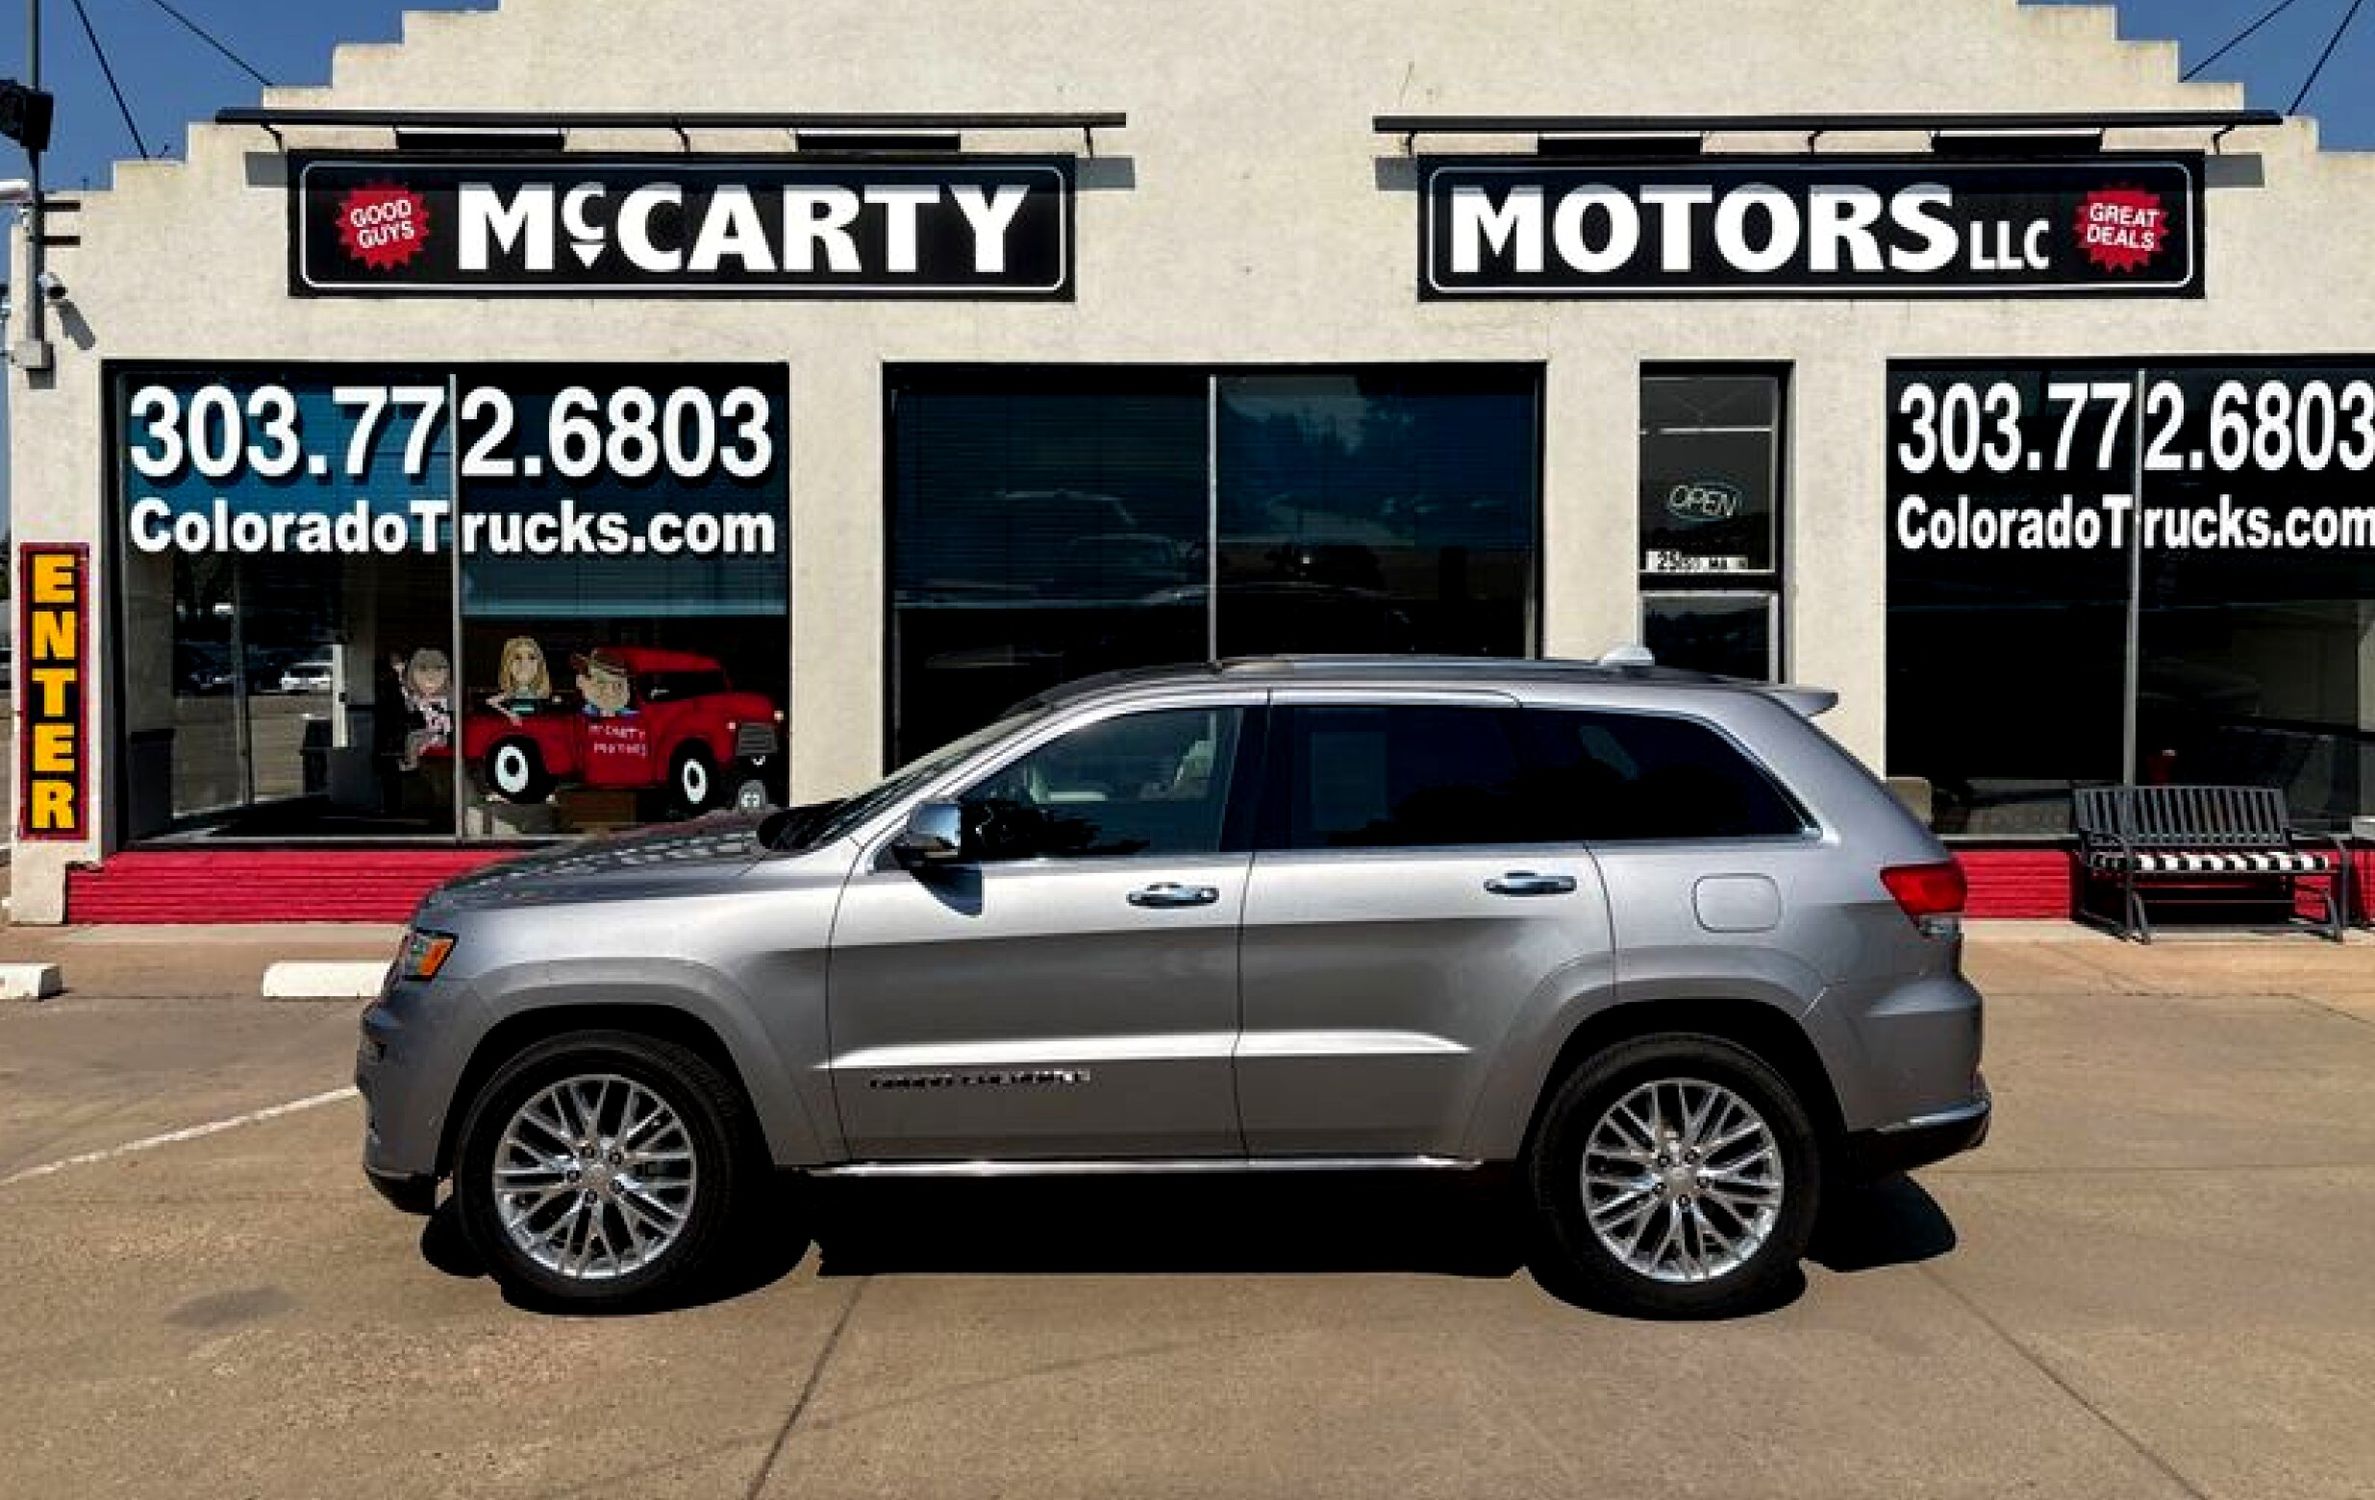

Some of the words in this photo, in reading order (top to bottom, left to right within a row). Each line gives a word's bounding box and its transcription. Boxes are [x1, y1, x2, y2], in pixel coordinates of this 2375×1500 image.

[350, 199, 411, 228] GOOD
[2089, 202, 2160, 228] GREAT
[357, 220, 415, 249] GUYS
[1451, 184, 1959, 273] MOTORS
[1969, 218, 2050, 271] LLC
[2086, 223, 2155, 252] DEALS
[1669, 484, 1737, 519] OPEN
[31, 553, 77, 829] ENTER
